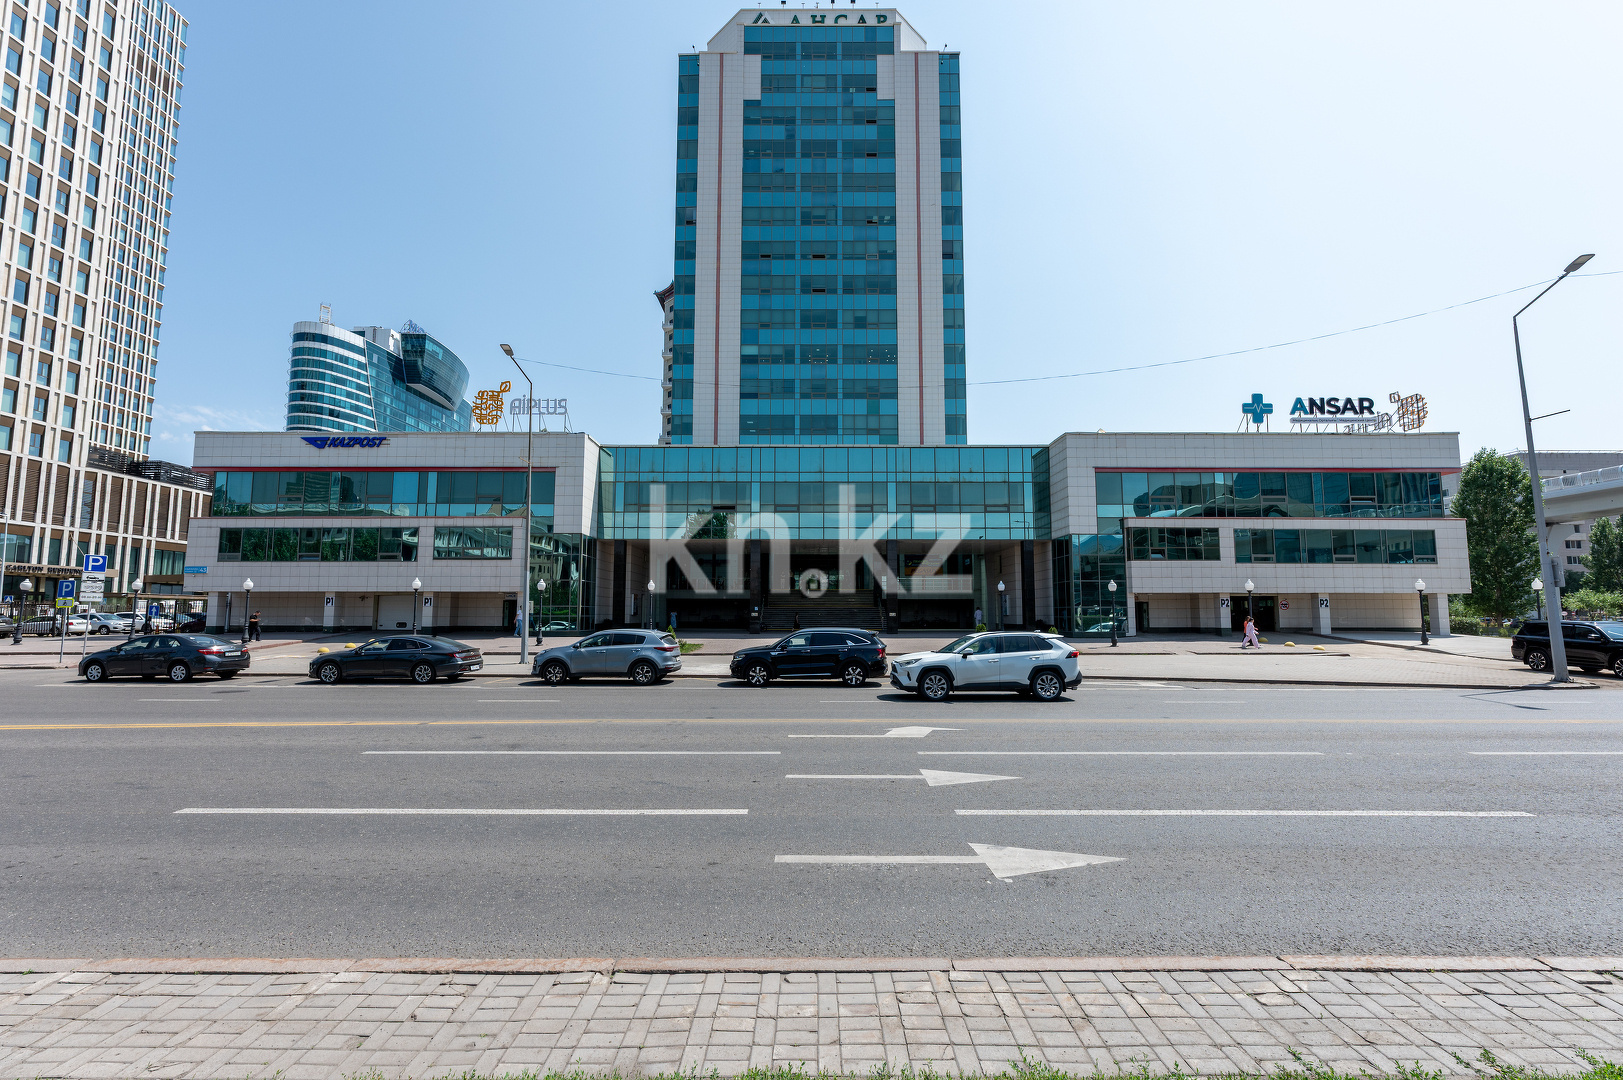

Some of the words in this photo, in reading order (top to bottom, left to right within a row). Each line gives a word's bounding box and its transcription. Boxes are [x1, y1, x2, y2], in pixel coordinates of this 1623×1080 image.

[1290, 397, 1375, 415] ANSAR
[327, 436, 387, 448] KAZPOST
[88, 556, 103, 571] P
[62, 582, 72, 596] P
[325, 597, 334, 606] P1
[424, 597, 432, 606] P1
[1220, 598, 1229, 607] P2
[1319, 598, 1329, 608] P2
